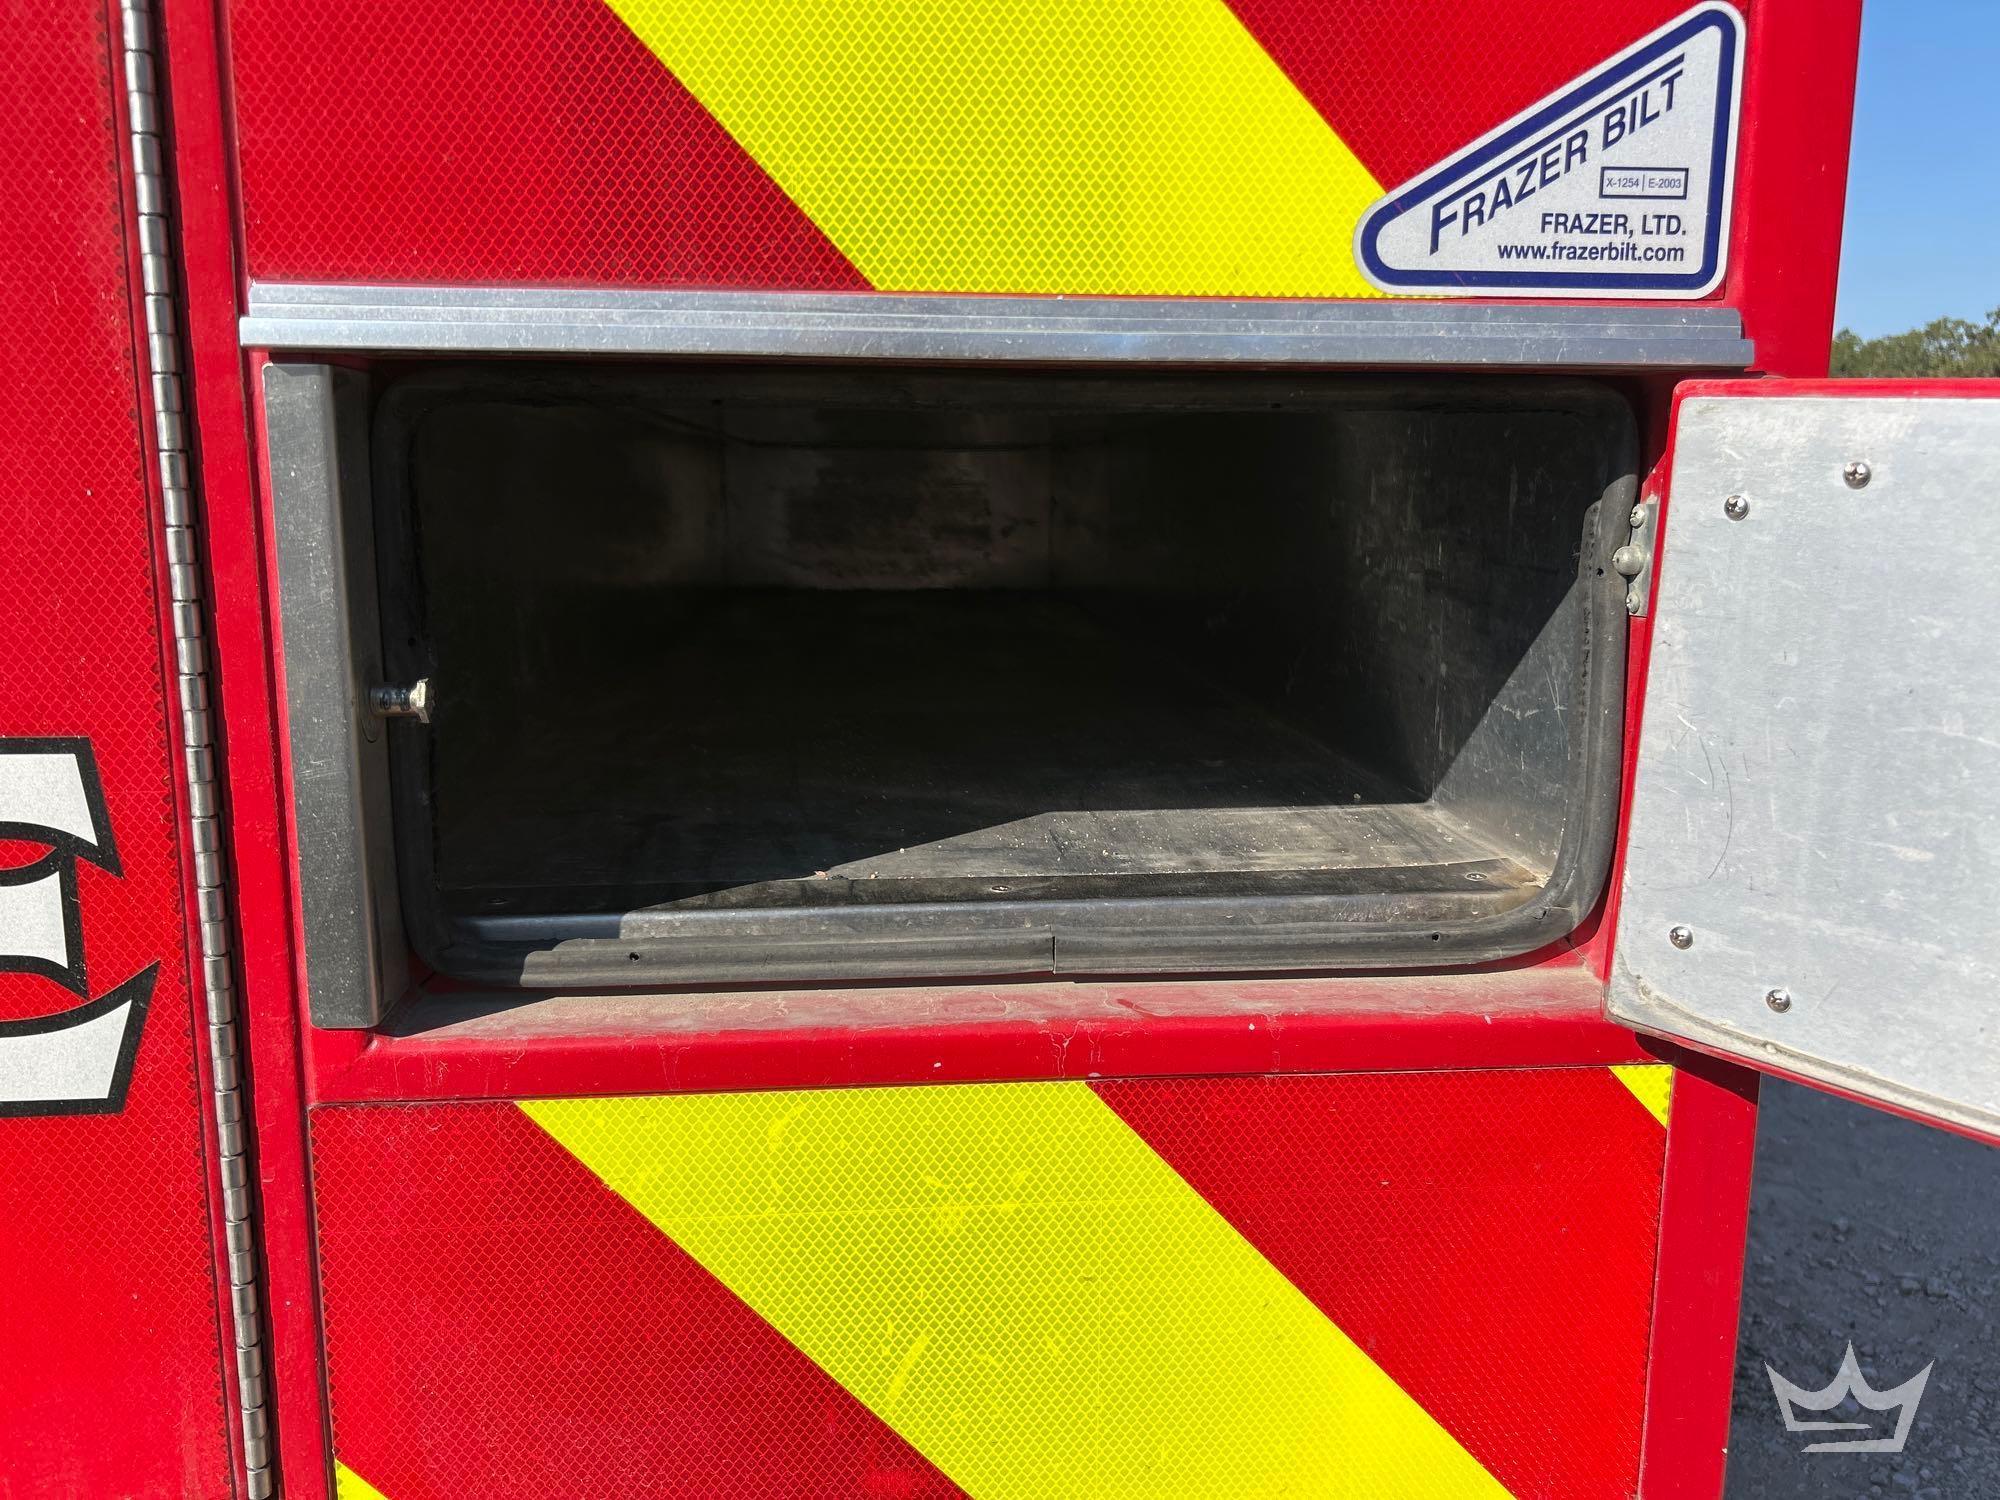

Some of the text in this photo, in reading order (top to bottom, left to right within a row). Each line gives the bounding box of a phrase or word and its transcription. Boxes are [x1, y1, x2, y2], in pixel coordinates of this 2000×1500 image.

[1429, 69, 1684, 256] FRAZER BILT
[1606, 177, 1681, 189] X-1254 E-2003
[1540, 213, 1687, 238] FRAZER, LTD.
[1497, 242, 1685, 262] www.frazerbilt.com
